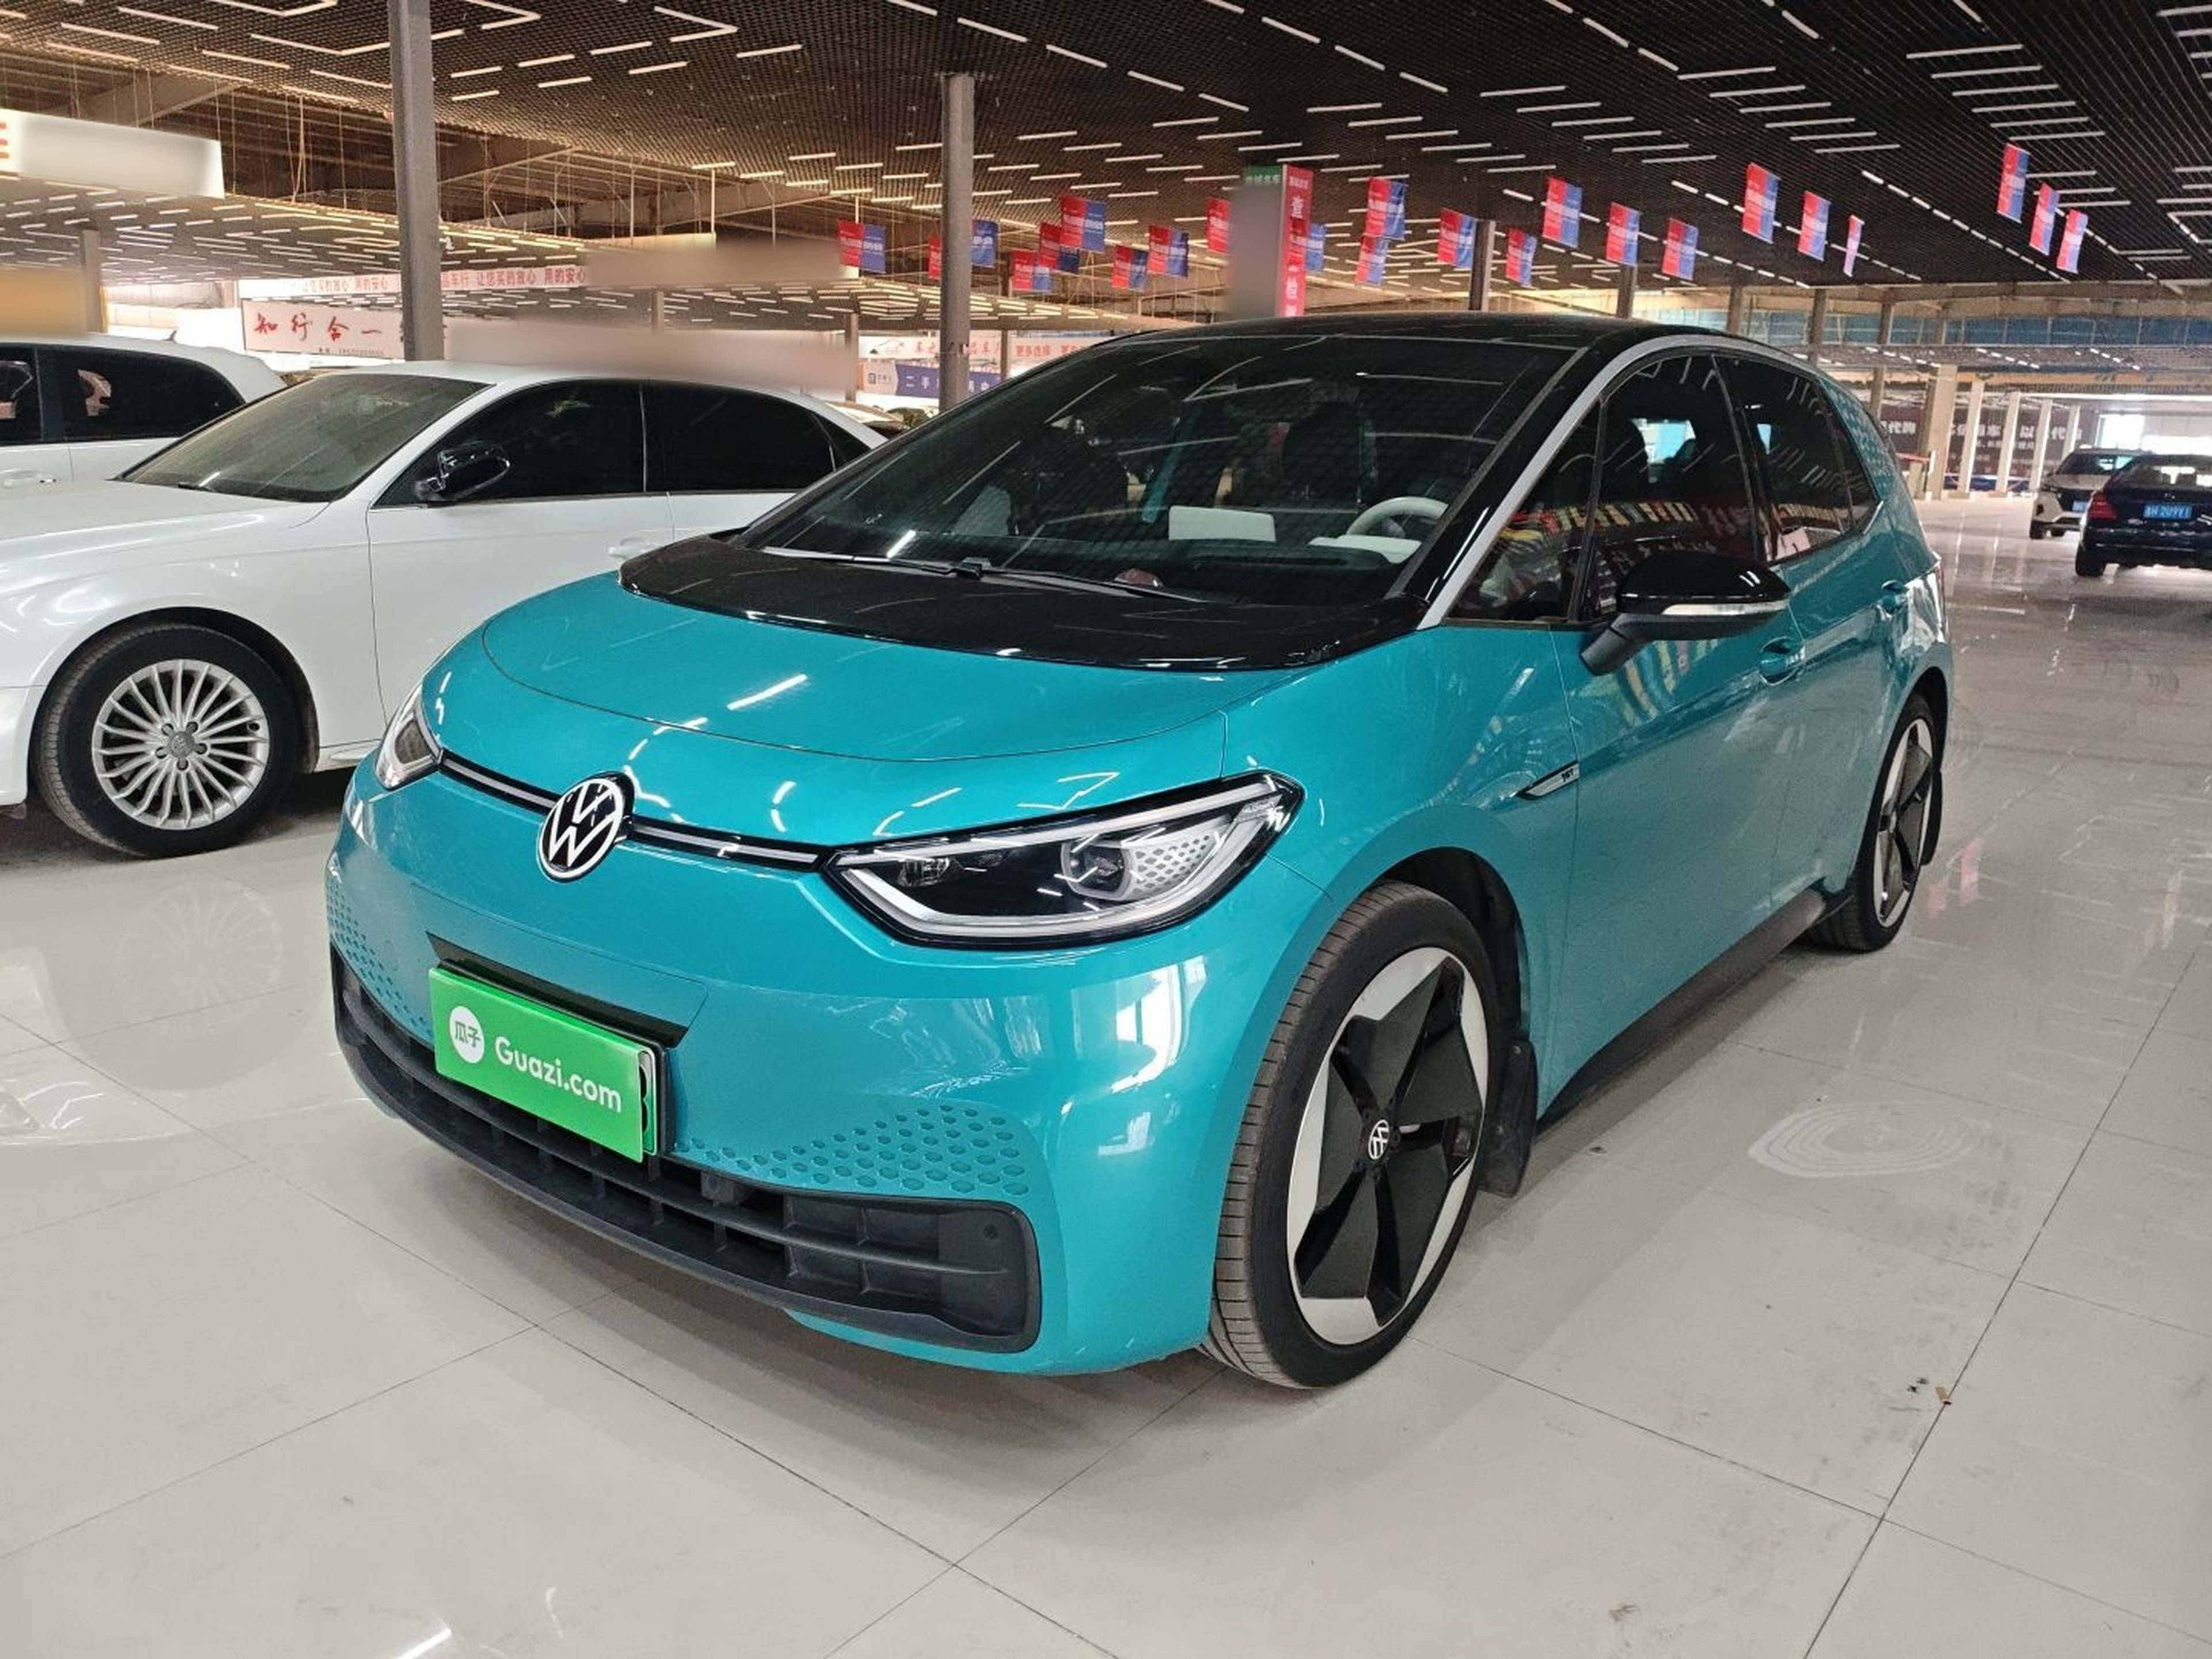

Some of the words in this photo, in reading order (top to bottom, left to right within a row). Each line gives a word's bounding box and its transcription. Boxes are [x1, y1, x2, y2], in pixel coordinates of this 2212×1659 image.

[254, 313, 382, 342] 知行合一
[454, 1021, 481, 1048] 瓜子
[495, 1036, 622, 1113] Guazi.com
